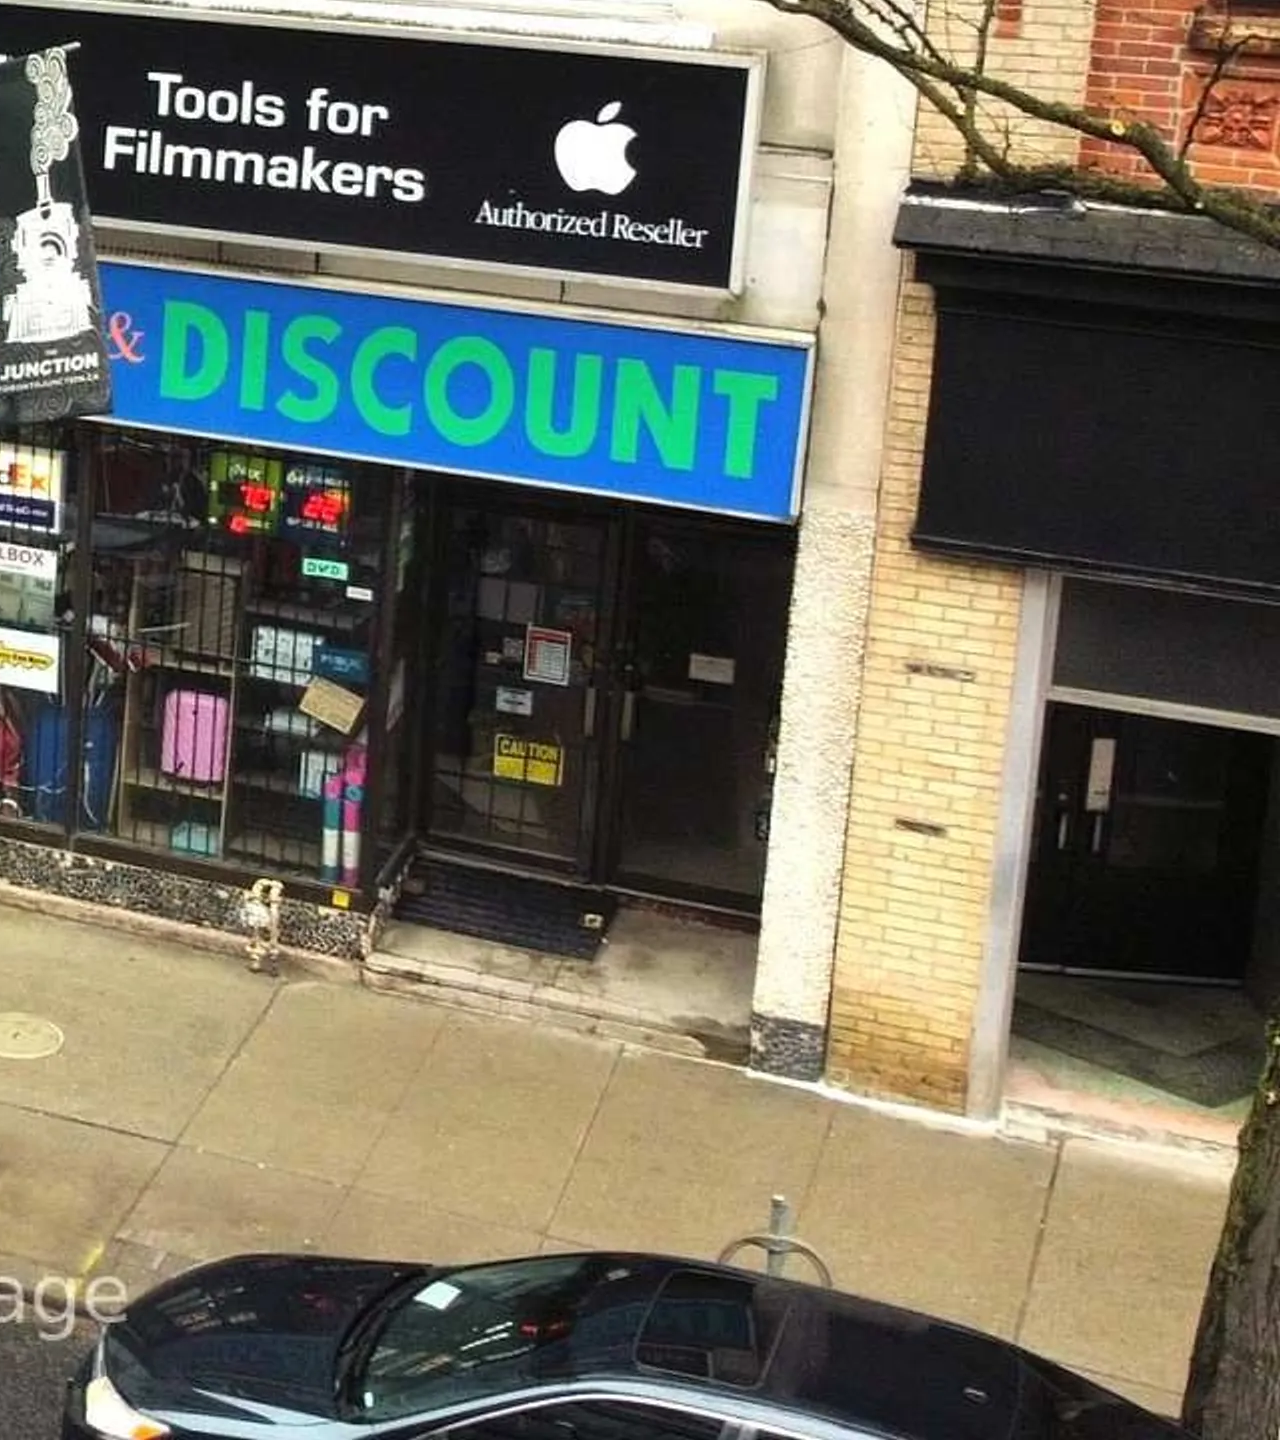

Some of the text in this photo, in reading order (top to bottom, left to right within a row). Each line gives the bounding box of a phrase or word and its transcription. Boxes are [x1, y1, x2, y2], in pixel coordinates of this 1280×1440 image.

[147, 71, 390, 137] Tools for
[103, 124, 426, 203] Filmmakers
[475, 199, 708, 251] Authorized Reseller
[0, 351, 99, 381] JUNCTION
[108, 300, 779, 480] & DISCOUNT
[499, 738, 559, 763] CAUTION
